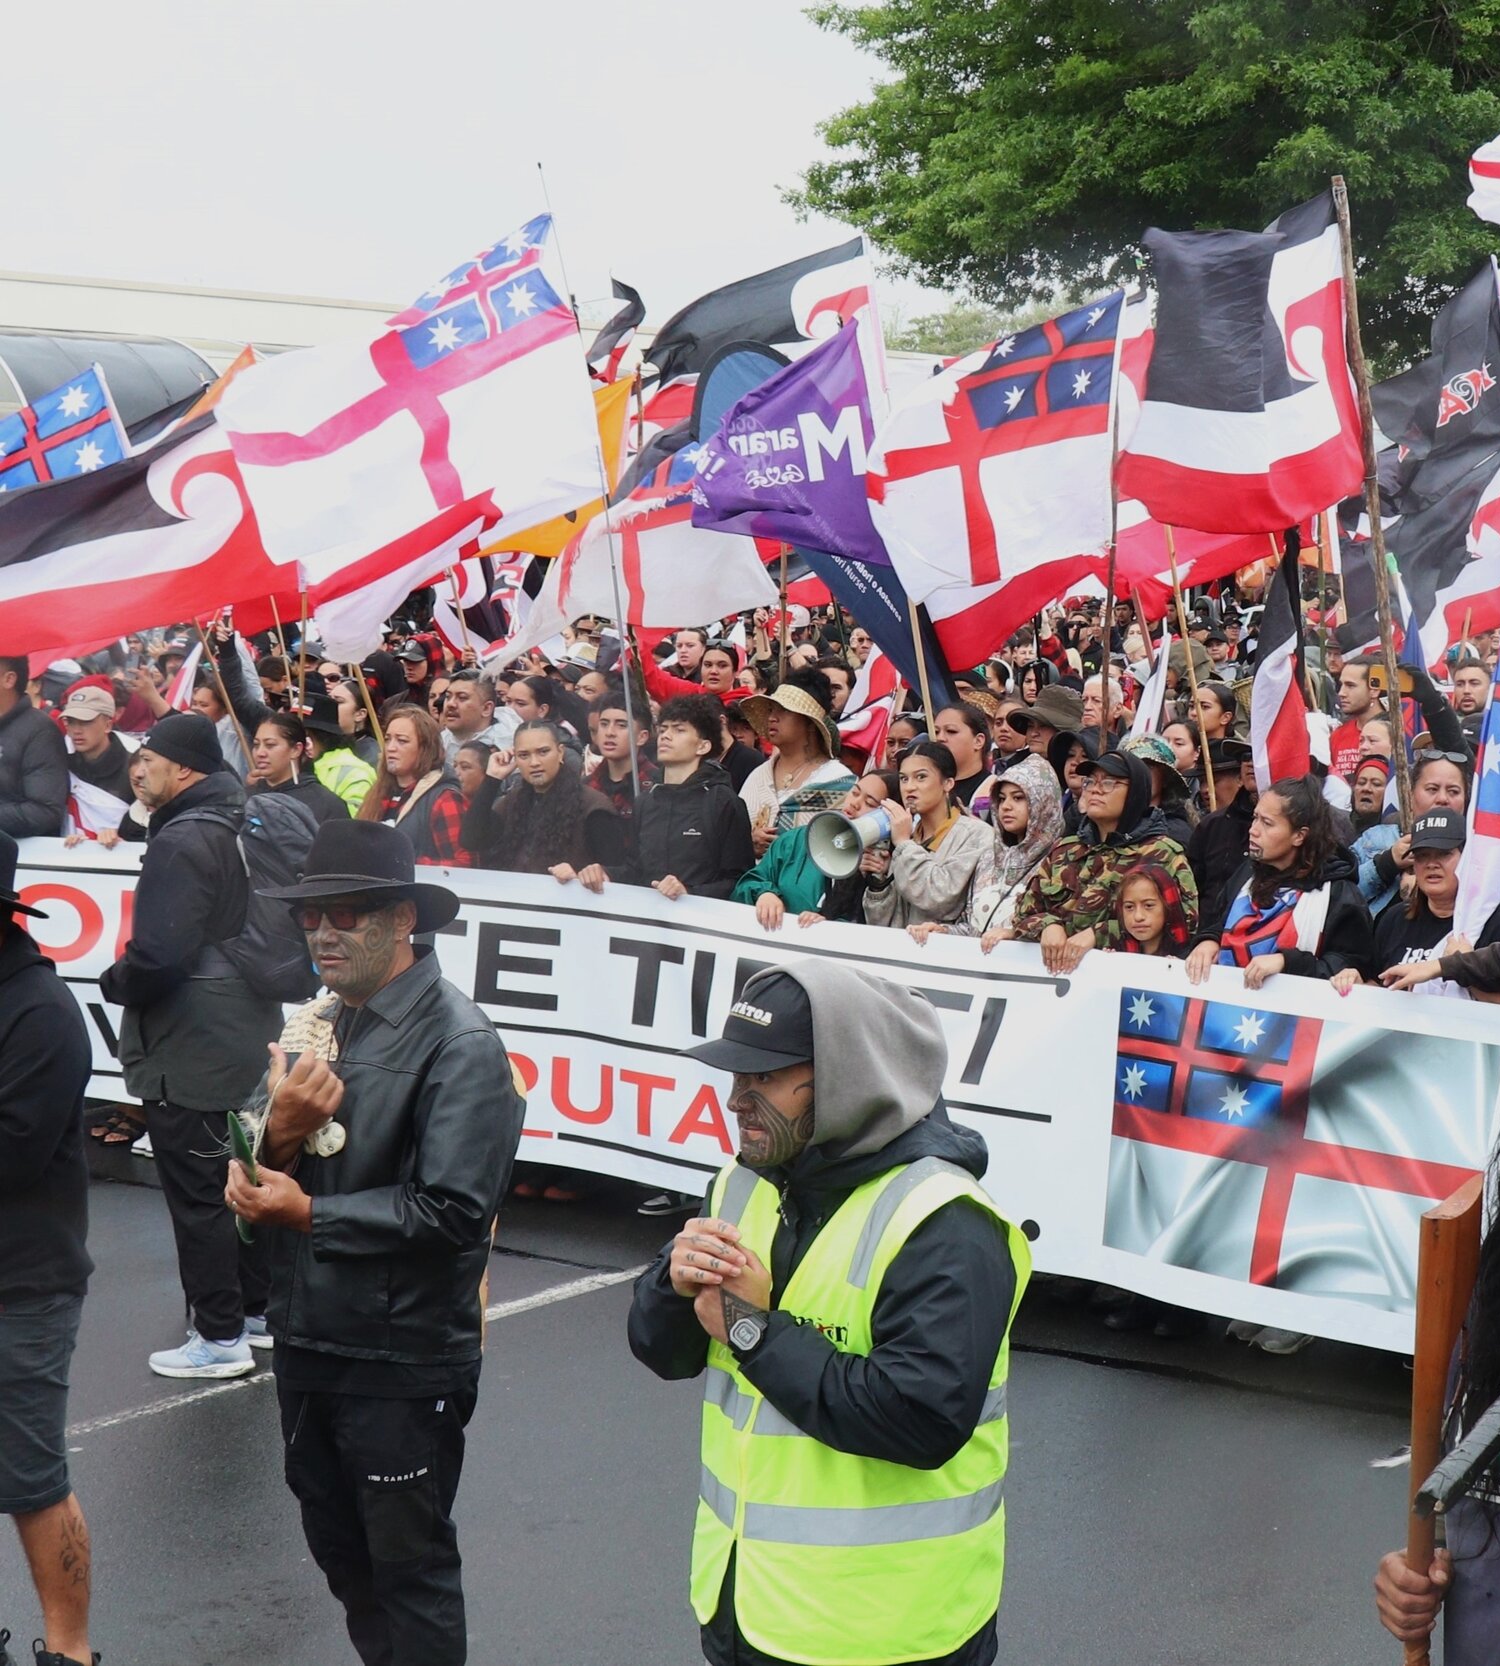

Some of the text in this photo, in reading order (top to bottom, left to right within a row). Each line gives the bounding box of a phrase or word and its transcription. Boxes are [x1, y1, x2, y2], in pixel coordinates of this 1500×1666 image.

[843, 564, 868, 594] Nurses
[1415, 817, 1448, 832] TE KAO
